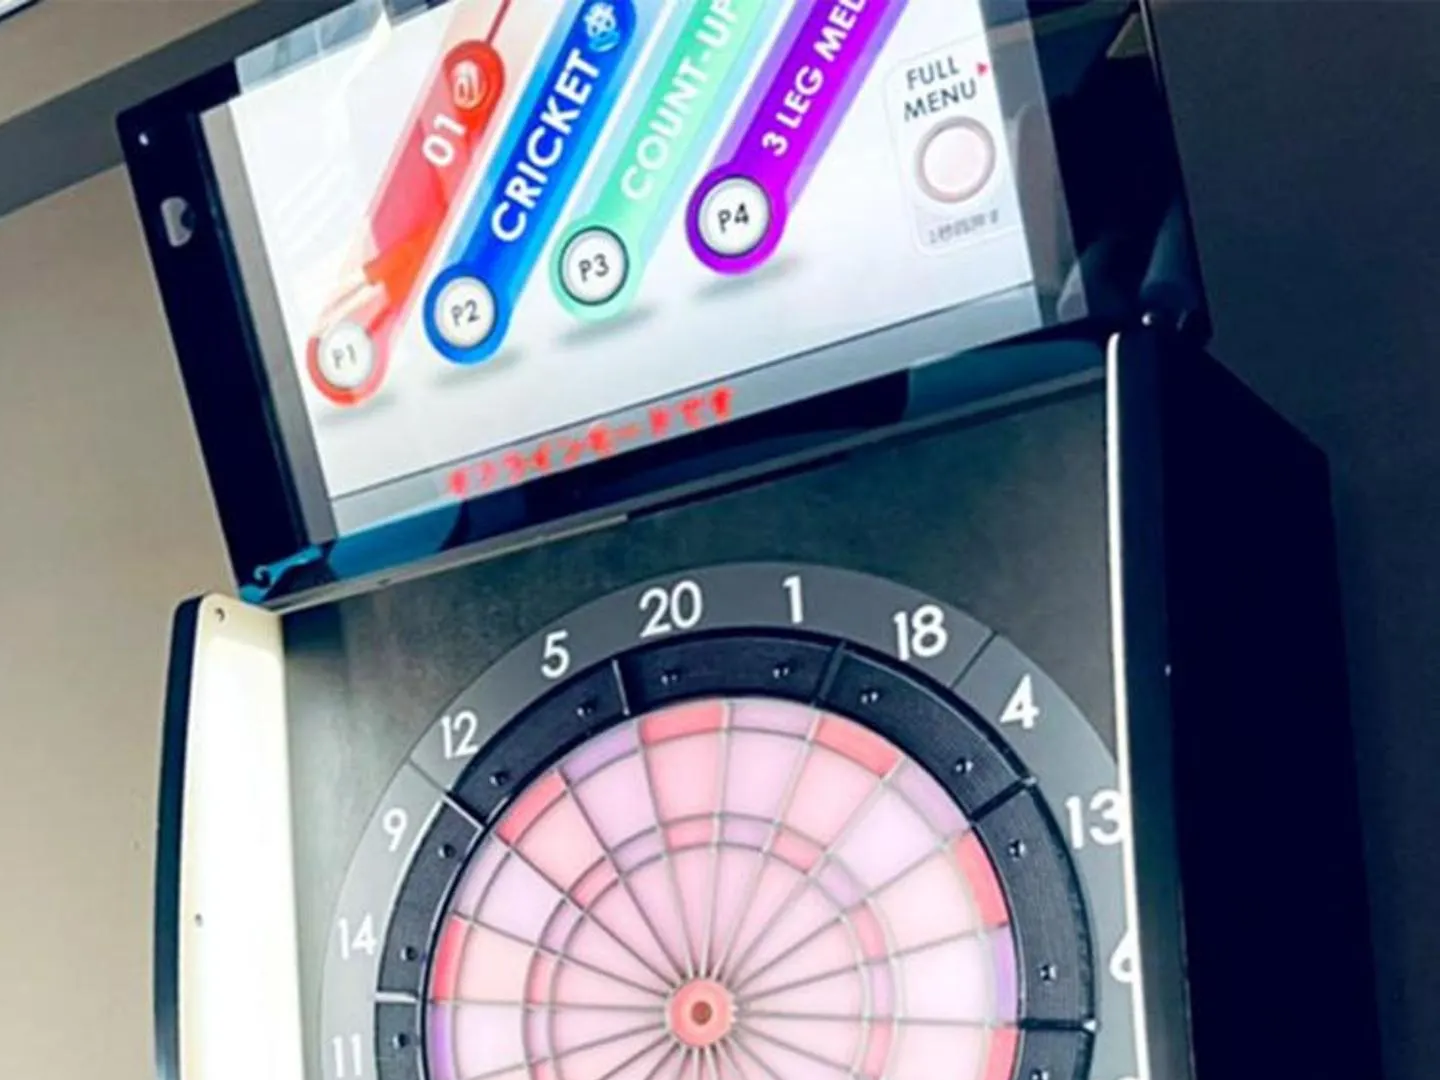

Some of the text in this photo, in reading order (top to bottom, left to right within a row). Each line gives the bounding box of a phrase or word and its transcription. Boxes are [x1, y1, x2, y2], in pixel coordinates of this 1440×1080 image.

[905, 55, 961, 91] FULL
[762, 131, 789, 157] 3
[776, 65, 825, 130] LEG
[902, 77, 979, 123] MENU
[422, 113, 467, 167] 01
[492, 48, 602, 243] CRICKET
[717, 203, 750, 234] P4
[577, 254, 610, 283] P3
[451, 300, 481, 327] P2
[639, 579, 703, 639] 20
[782, 575, 803, 625] 1
[541, 630, 570, 679] 5
[893, 604, 948, 661] 18
[1000, 673, 1040, 730] 4
[439, 710, 479, 760] 12
[382, 807, 408, 853] 9
[1065, 788, 1126, 850] 13
[337, 913, 378, 961] 14
[331, 1033, 362, 1079] 11
